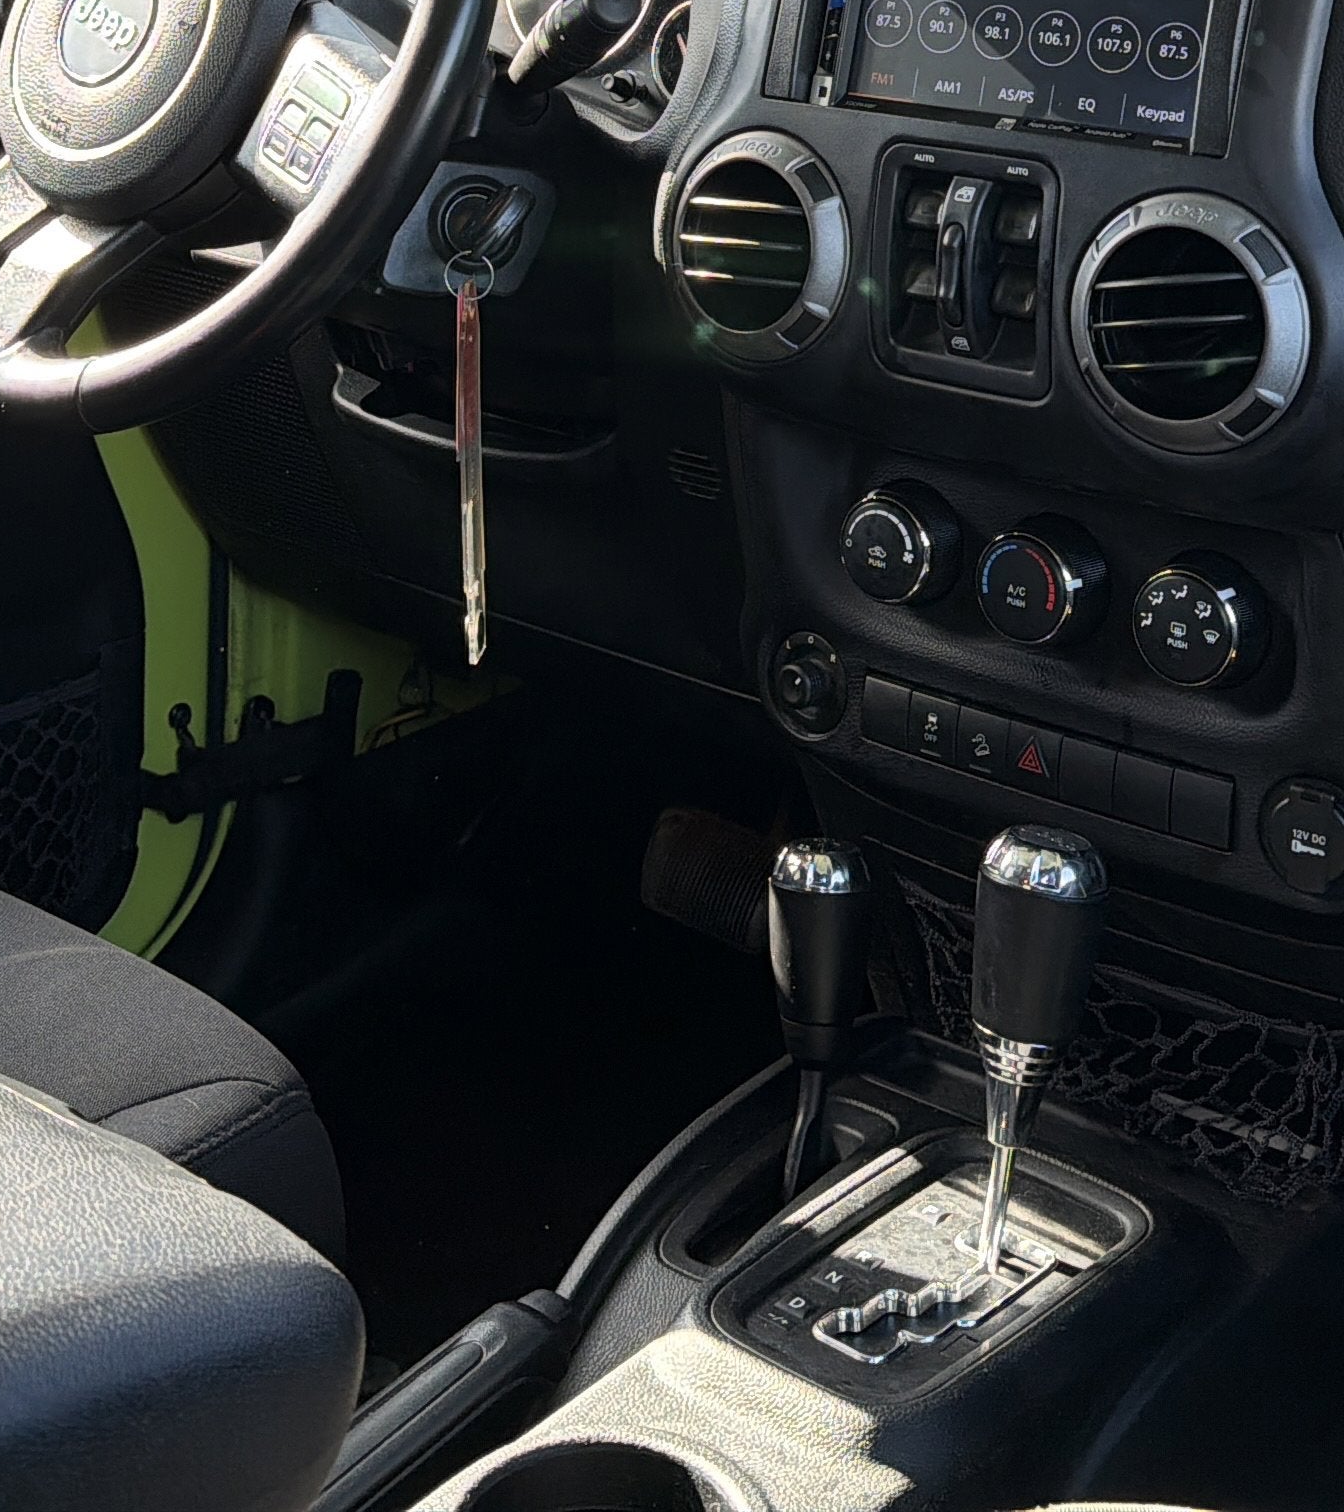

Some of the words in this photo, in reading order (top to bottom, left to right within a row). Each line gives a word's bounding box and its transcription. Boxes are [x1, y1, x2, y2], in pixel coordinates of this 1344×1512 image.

[886, 0, 896, 10] P1
[939, 6, 950, 17] P2
[875, 14, 901, 29] 87.5
[994, 11, 1006, 22] P3
[1051, 17, 1064, 28] P4
[928, 19, 954, 34] 90.1
[984, 25, 1010, 40] 98.1
[1110, 23, 1123, 34] P5
[1037, 31, 1071, 47] 106.1
[1170, 30, 1183, 40] P6
[1096, 37, 1132, 53] 107.9
[1159, 44, 1188, 60] 87.5
[870, 72, 895, 85] FM1
[933, 79, 961, 94] AM1
[997, 88, 1035, 104] AS/PS
[1077, 97, 1096, 113] EQ
[1136, 105, 1185, 123] Keypad
[913, 152, 935, 163] AUTO
[1006, 165, 1029, 177] AUTO
[867, 558, 887, 570] PUSH
[1007, 583, 1027, 597] A/C
[1006, 597, 1027, 609] PUSH
[1166, 637, 1188, 650] PUSH
[1292, 828, 1310, 841] 12V
[1311, 833, 1327, 846] DC
[824, 1270, 844, 1284] N
[788, 1296, 806, 1309] D
